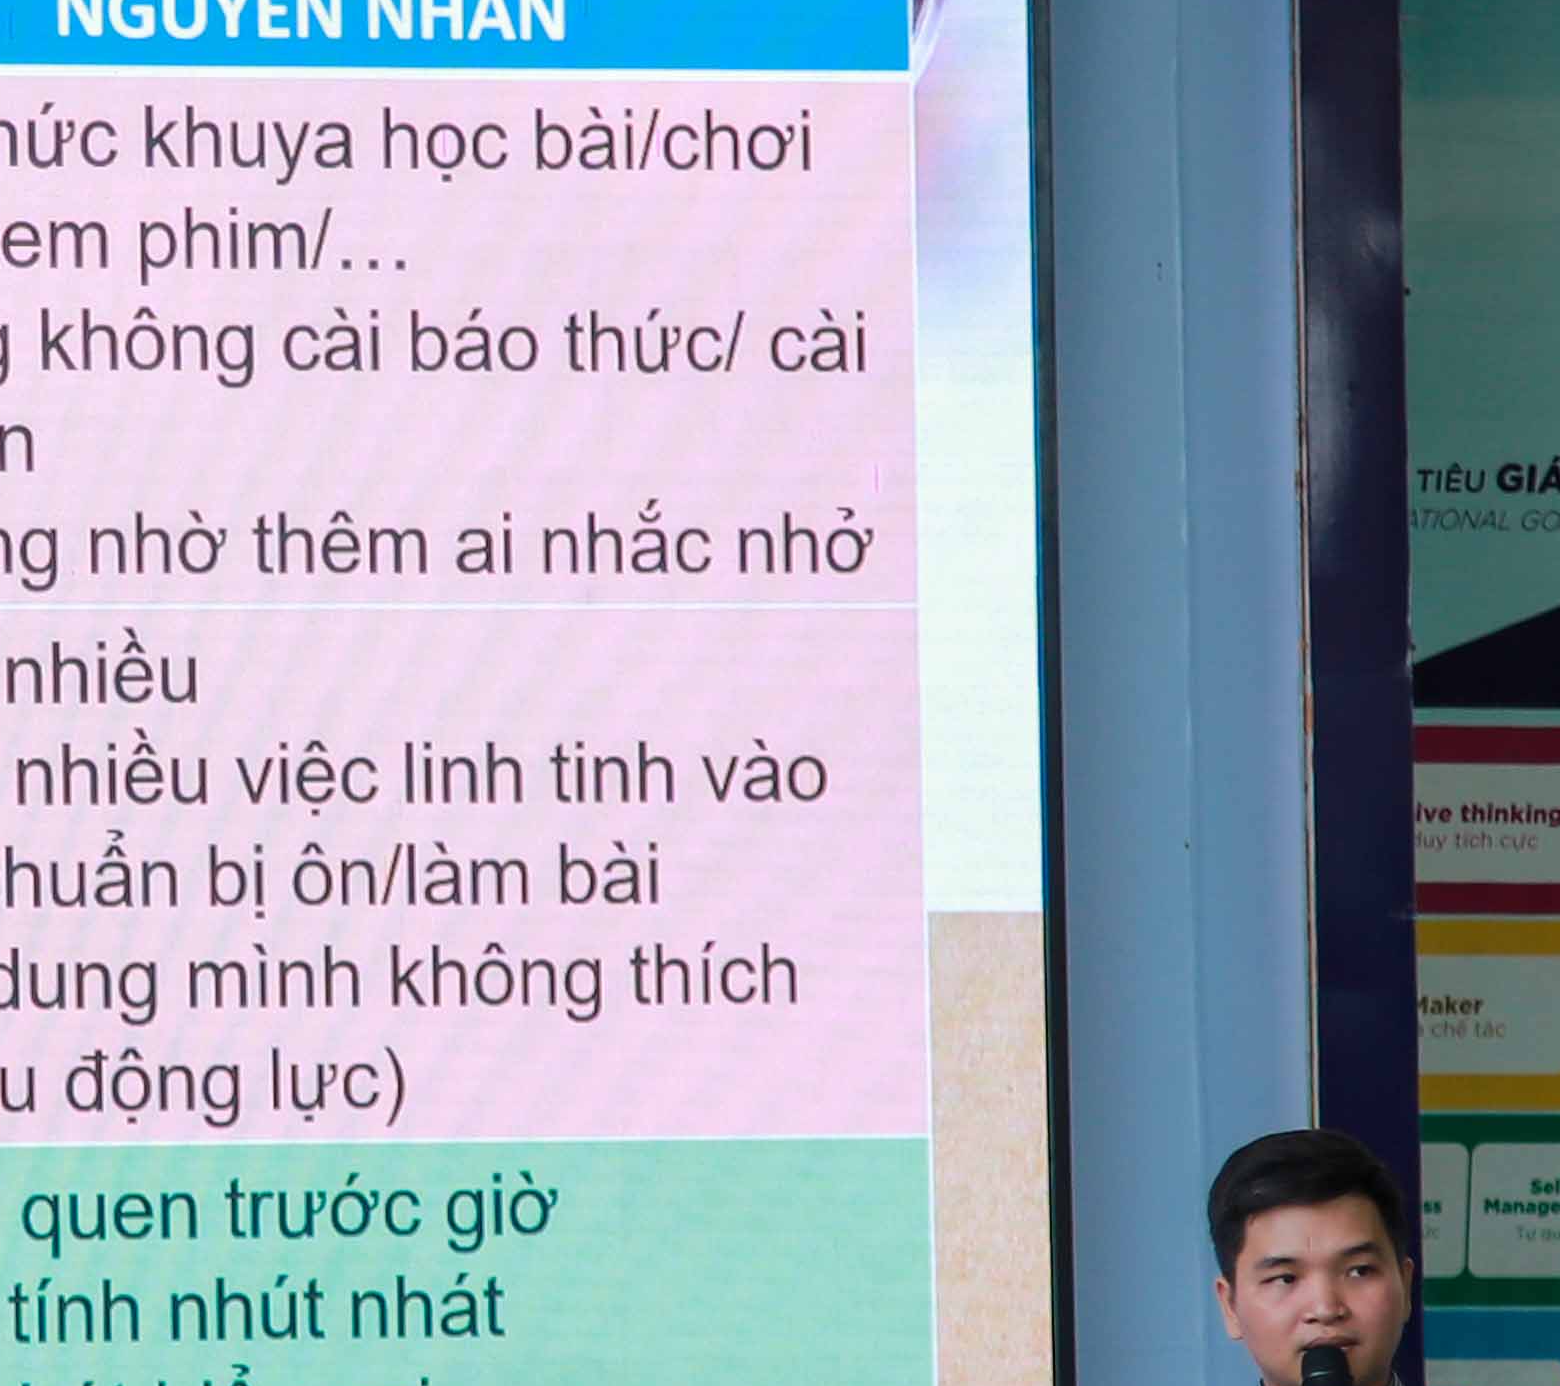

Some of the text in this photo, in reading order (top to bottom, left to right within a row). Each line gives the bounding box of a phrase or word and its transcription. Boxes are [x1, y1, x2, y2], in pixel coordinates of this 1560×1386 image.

[142, 102, 355, 188] khuya
[381, 104, 510, 185] học
[533, 104, 813, 173] bài/chơi
[1414, 459, 1488, 496] TIÊU
[63, 1045, 242, 1131] động
[269, 1044, 407, 1129] lực)
